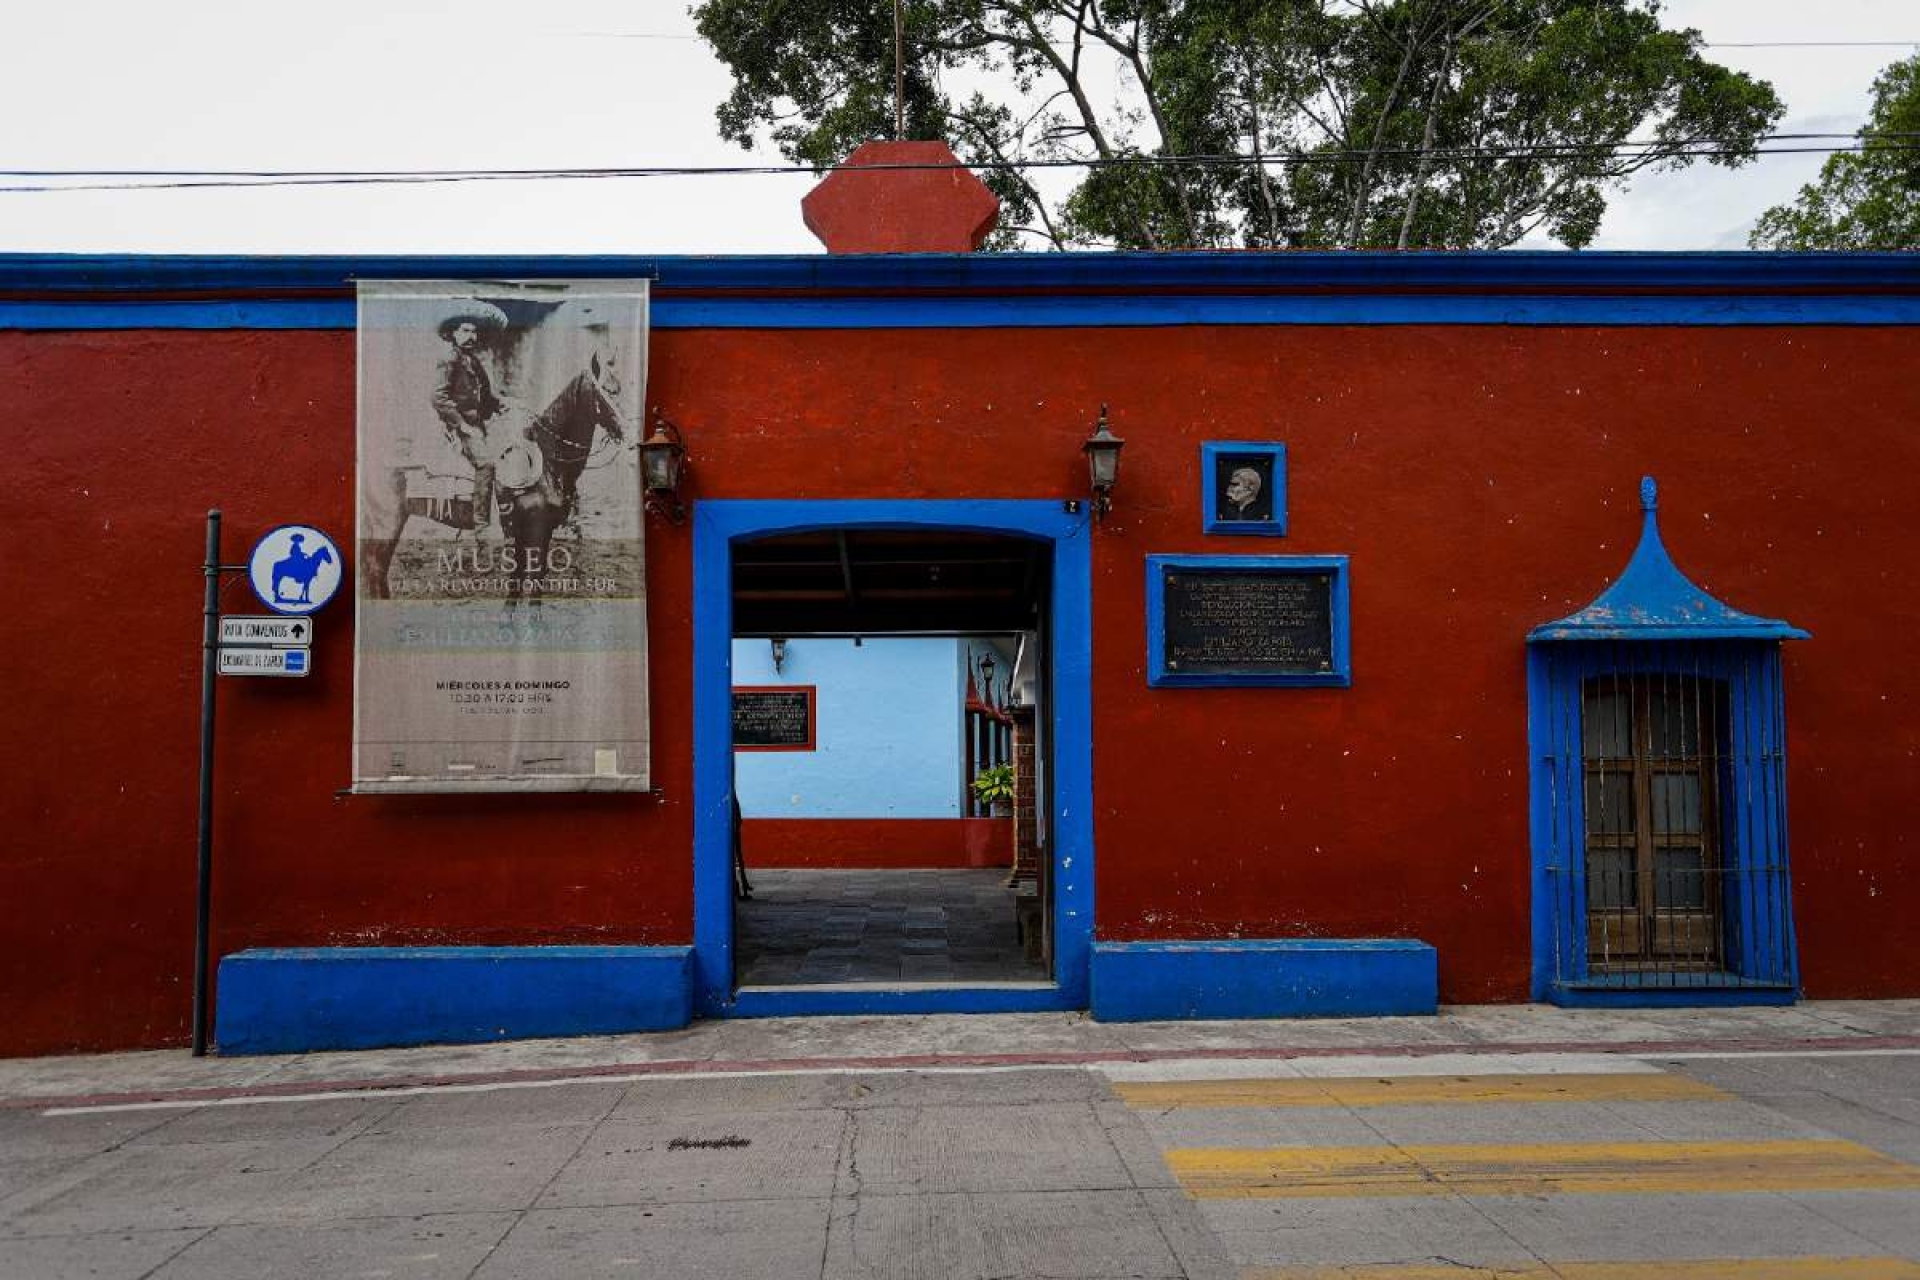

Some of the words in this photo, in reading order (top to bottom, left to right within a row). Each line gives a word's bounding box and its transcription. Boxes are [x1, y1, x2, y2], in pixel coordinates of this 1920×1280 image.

[437, 547, 571, 572] MUSEO
[586, 578, 616, 592] SUR
[503, 681, 512, 690] A
[514, 681, 571, 690] DOMINGO
